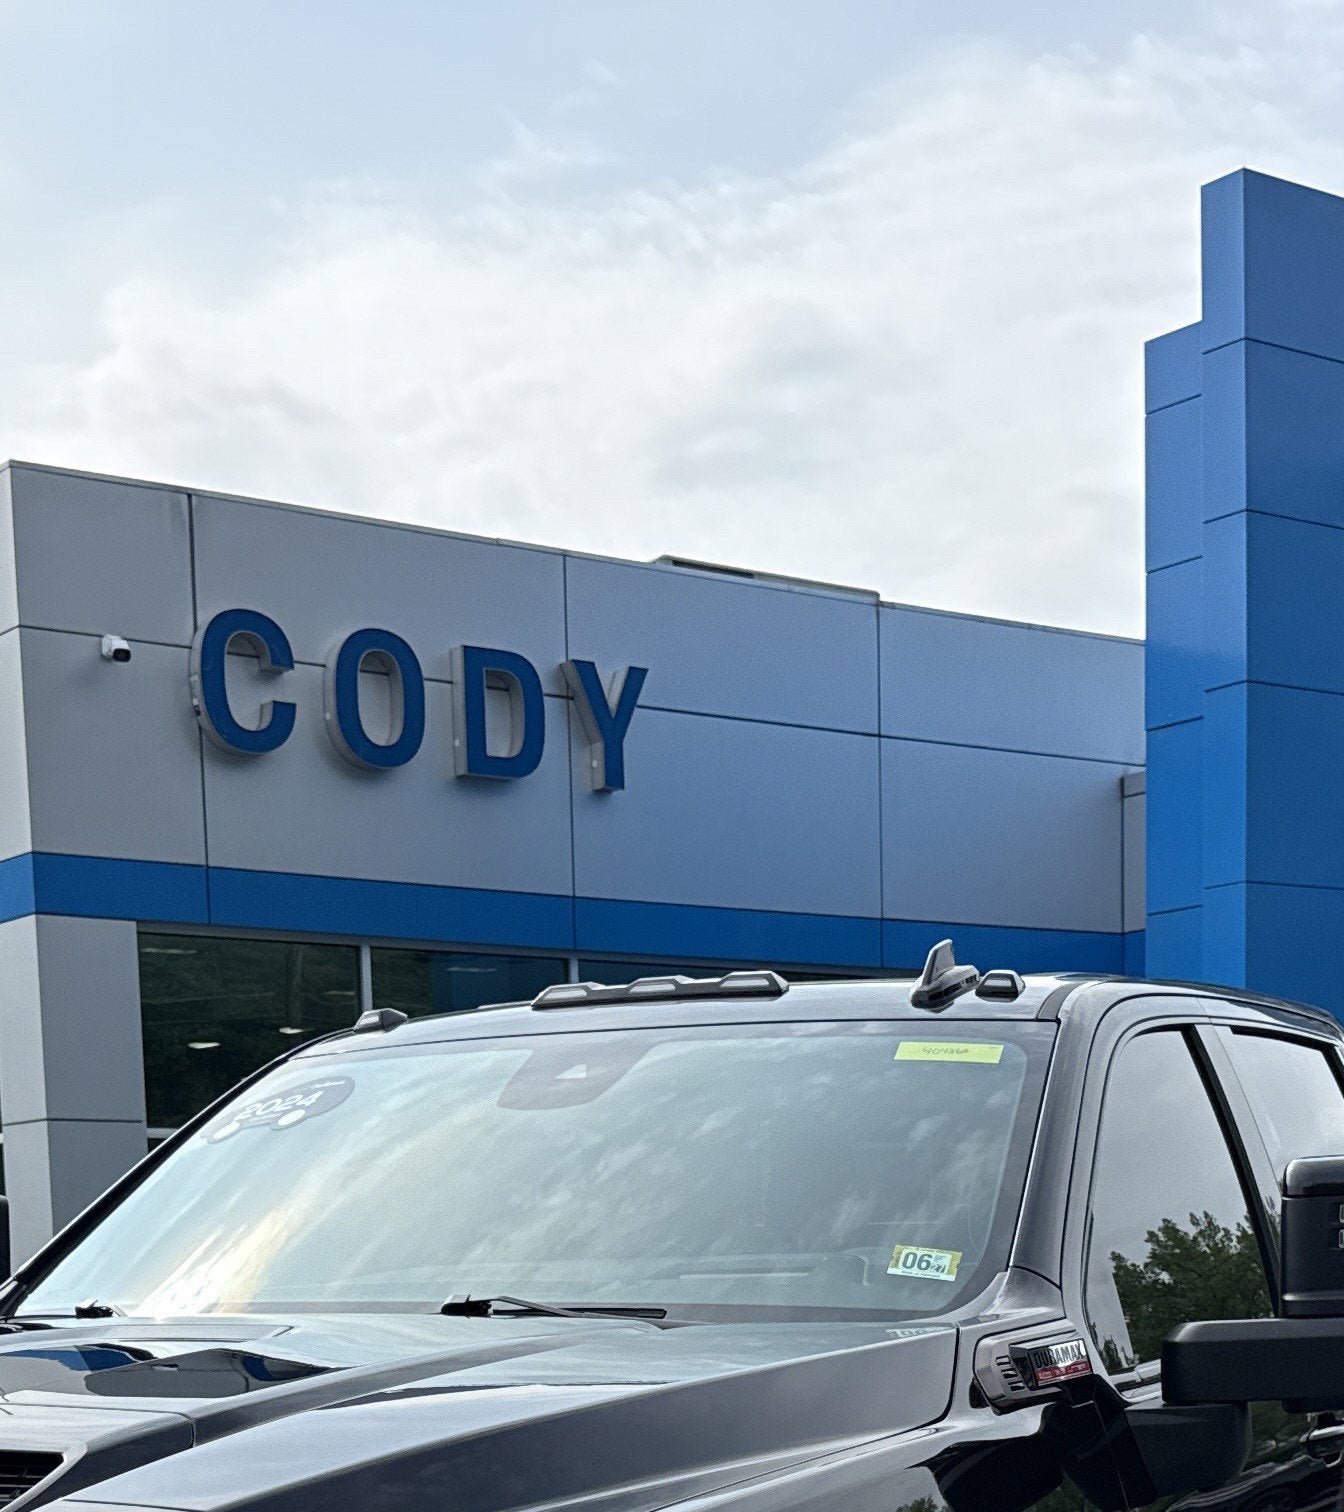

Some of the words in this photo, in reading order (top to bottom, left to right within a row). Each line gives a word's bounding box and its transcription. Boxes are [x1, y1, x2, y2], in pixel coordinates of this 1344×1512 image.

[193, 607, 649, 793] CODY
[234, 1091, 325, 1122] 2024
[902, 1252, 933, 1271] 06
[1033, 1341, 1084, 1368] DURAMAX
